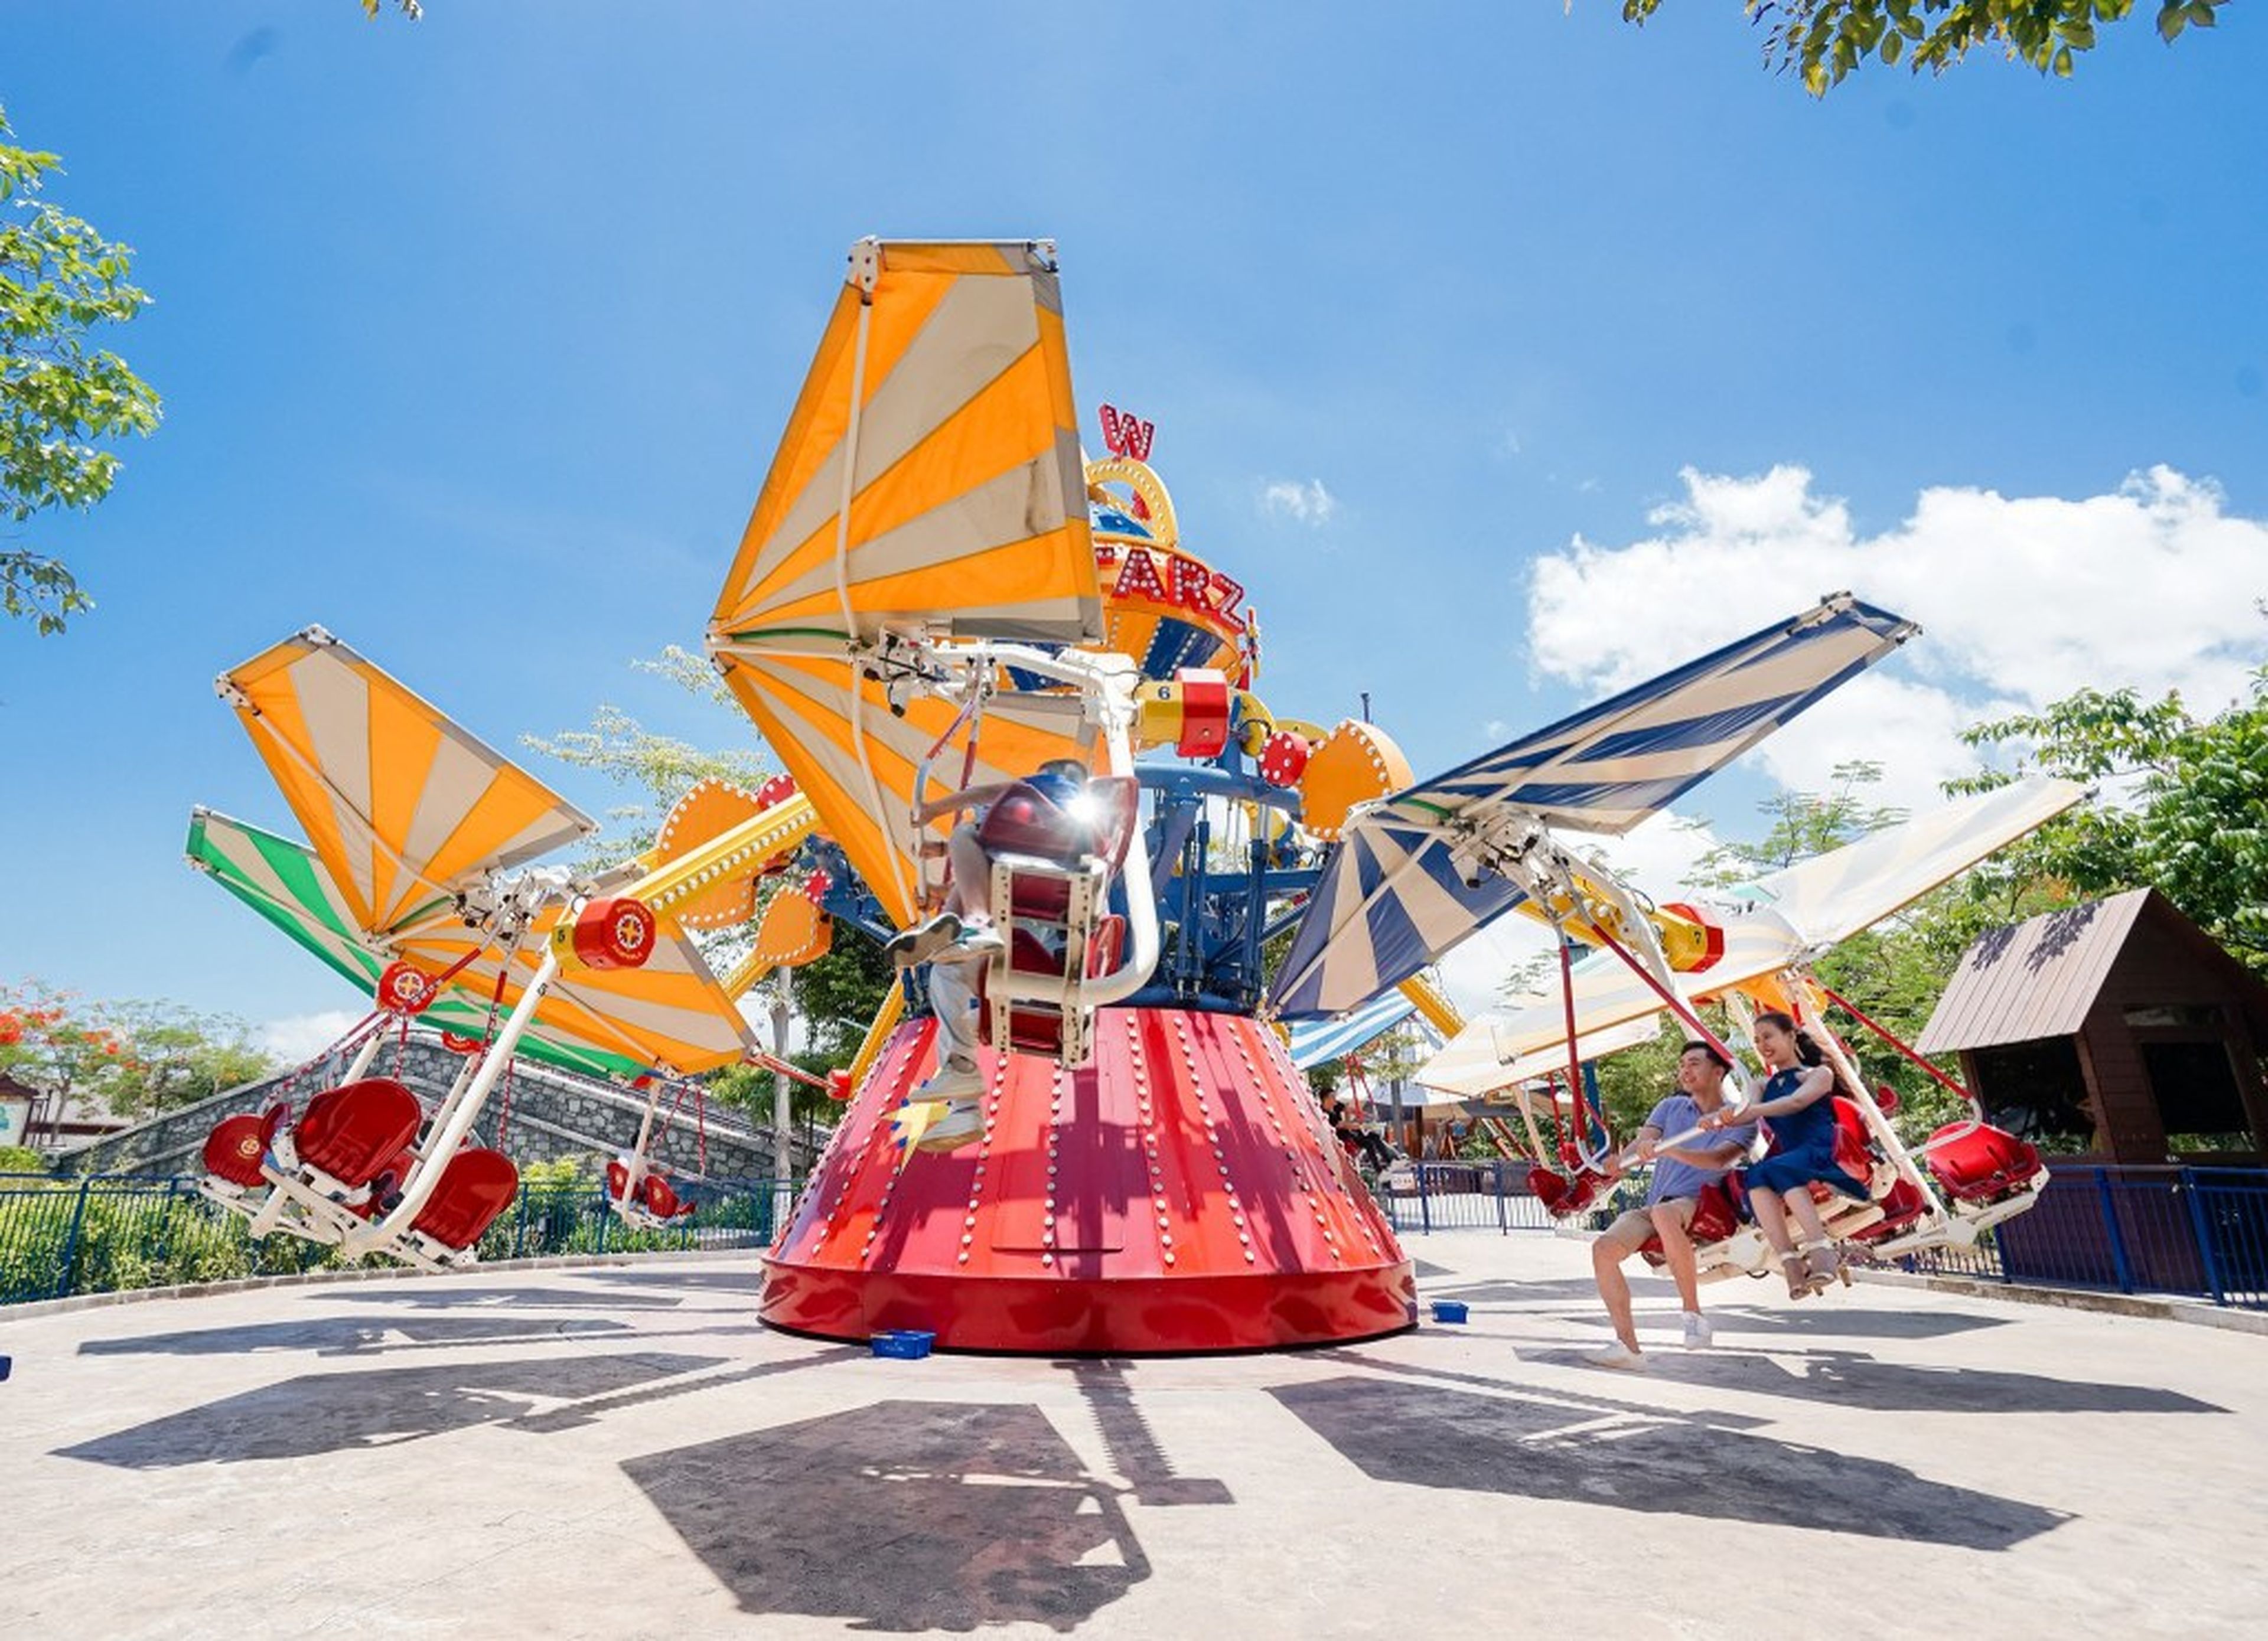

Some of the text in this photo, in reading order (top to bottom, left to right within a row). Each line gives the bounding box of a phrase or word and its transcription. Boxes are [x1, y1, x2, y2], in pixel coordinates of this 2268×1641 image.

[1099, 403, 1155, 463] W
[1158, 686, 1171, 700] 6
[558, 928, 566, 943] 5
